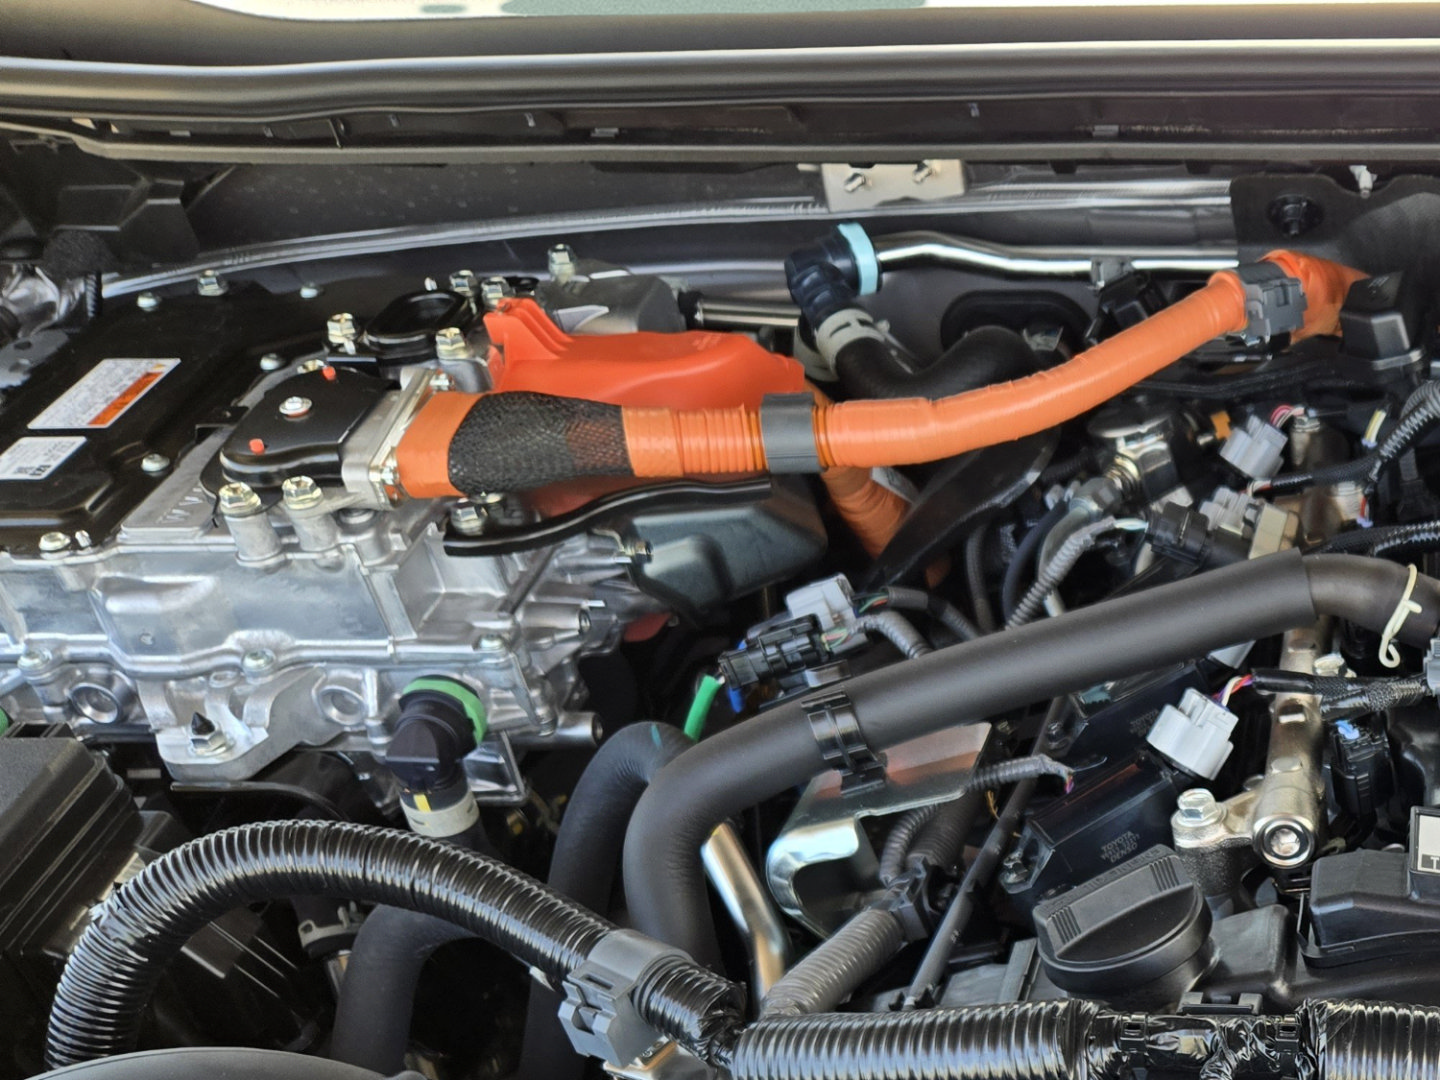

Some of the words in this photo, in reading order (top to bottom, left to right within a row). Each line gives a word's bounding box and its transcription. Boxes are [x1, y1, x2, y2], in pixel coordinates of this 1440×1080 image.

[1100, 830, 1134, 851] TOYOTA
[1110, 842, 1138, 863] DENSO
[1430, 856, 1440, 871] T
